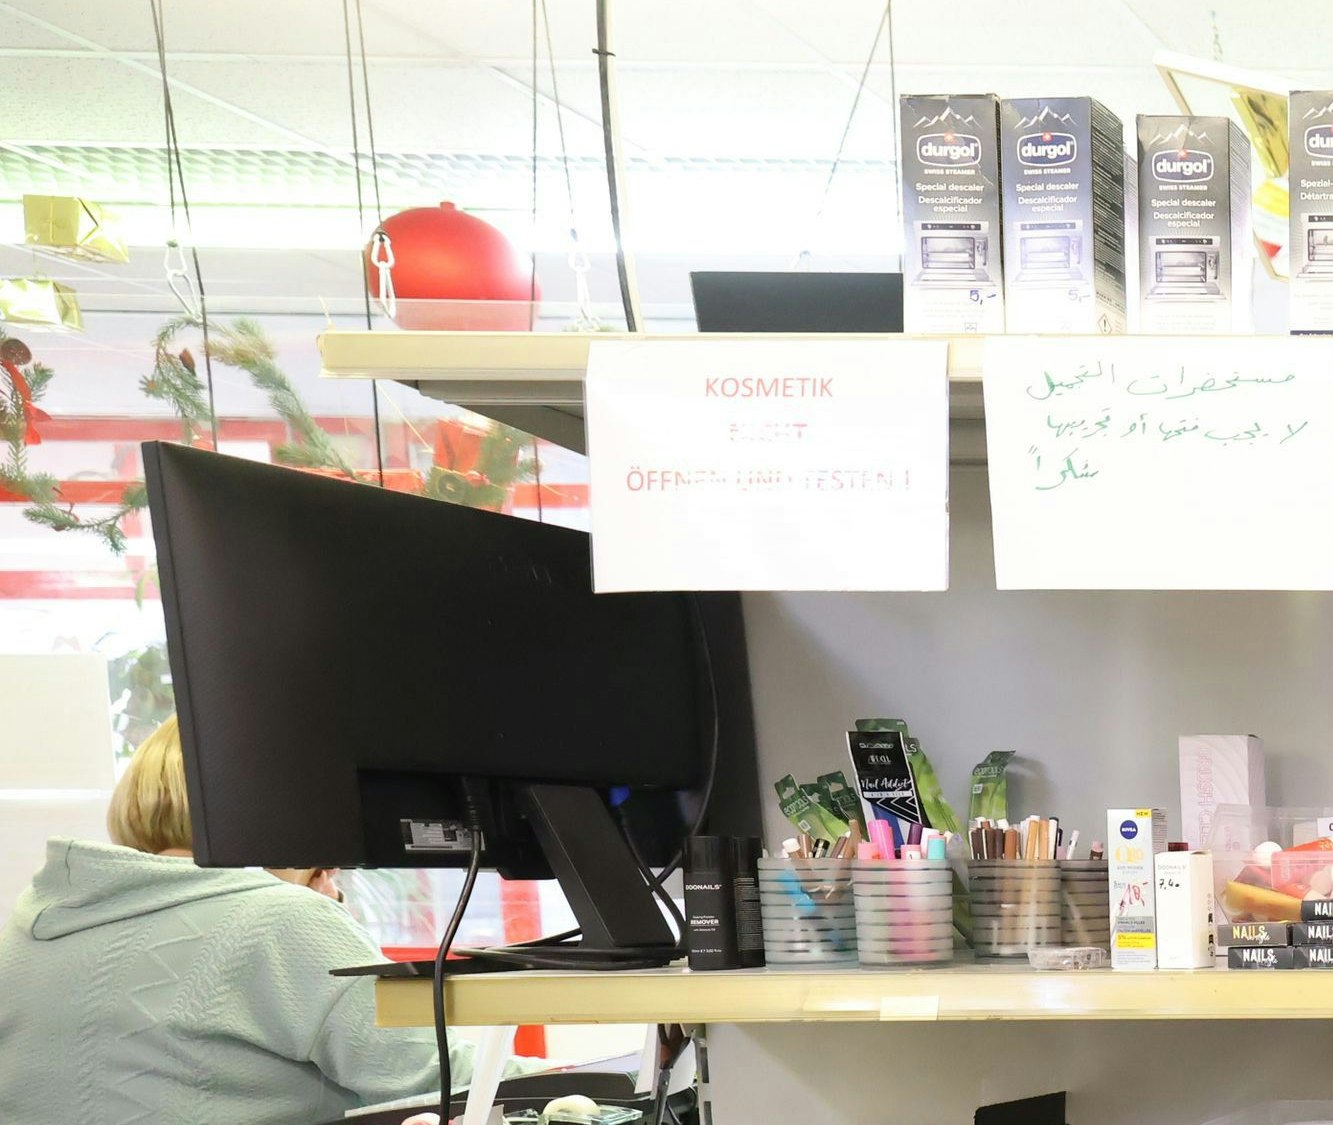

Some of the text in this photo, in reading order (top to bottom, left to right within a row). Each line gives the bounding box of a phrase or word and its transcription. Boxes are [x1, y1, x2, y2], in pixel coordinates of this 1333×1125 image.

[920, 140, 976, 160] durgol
[1020, 140, 1072, 160] durgol
[1155, 160, 1210, 179] durgol
[915, 181, 985, 194] Special descaler
[1015, 181, 1080, 194] Special descaler
[918, 195, 984, 206] Descalcificador
[1018, 195, 1078, 206] Descalcificador
[1151, 199, 1217, 211] Special descaler
[933, 204, 969, 215] especial
[1031, 203, 1065, 214] especial
[1153, 210, 1216, 222] Descalcificador
[1166, 220, 1201, 230] especial
[704, 376, 834, 399] KOSMETIK
[1232, 924, 1265, 940] NAILS
[1242, 948, 1275, 964] NAILS
